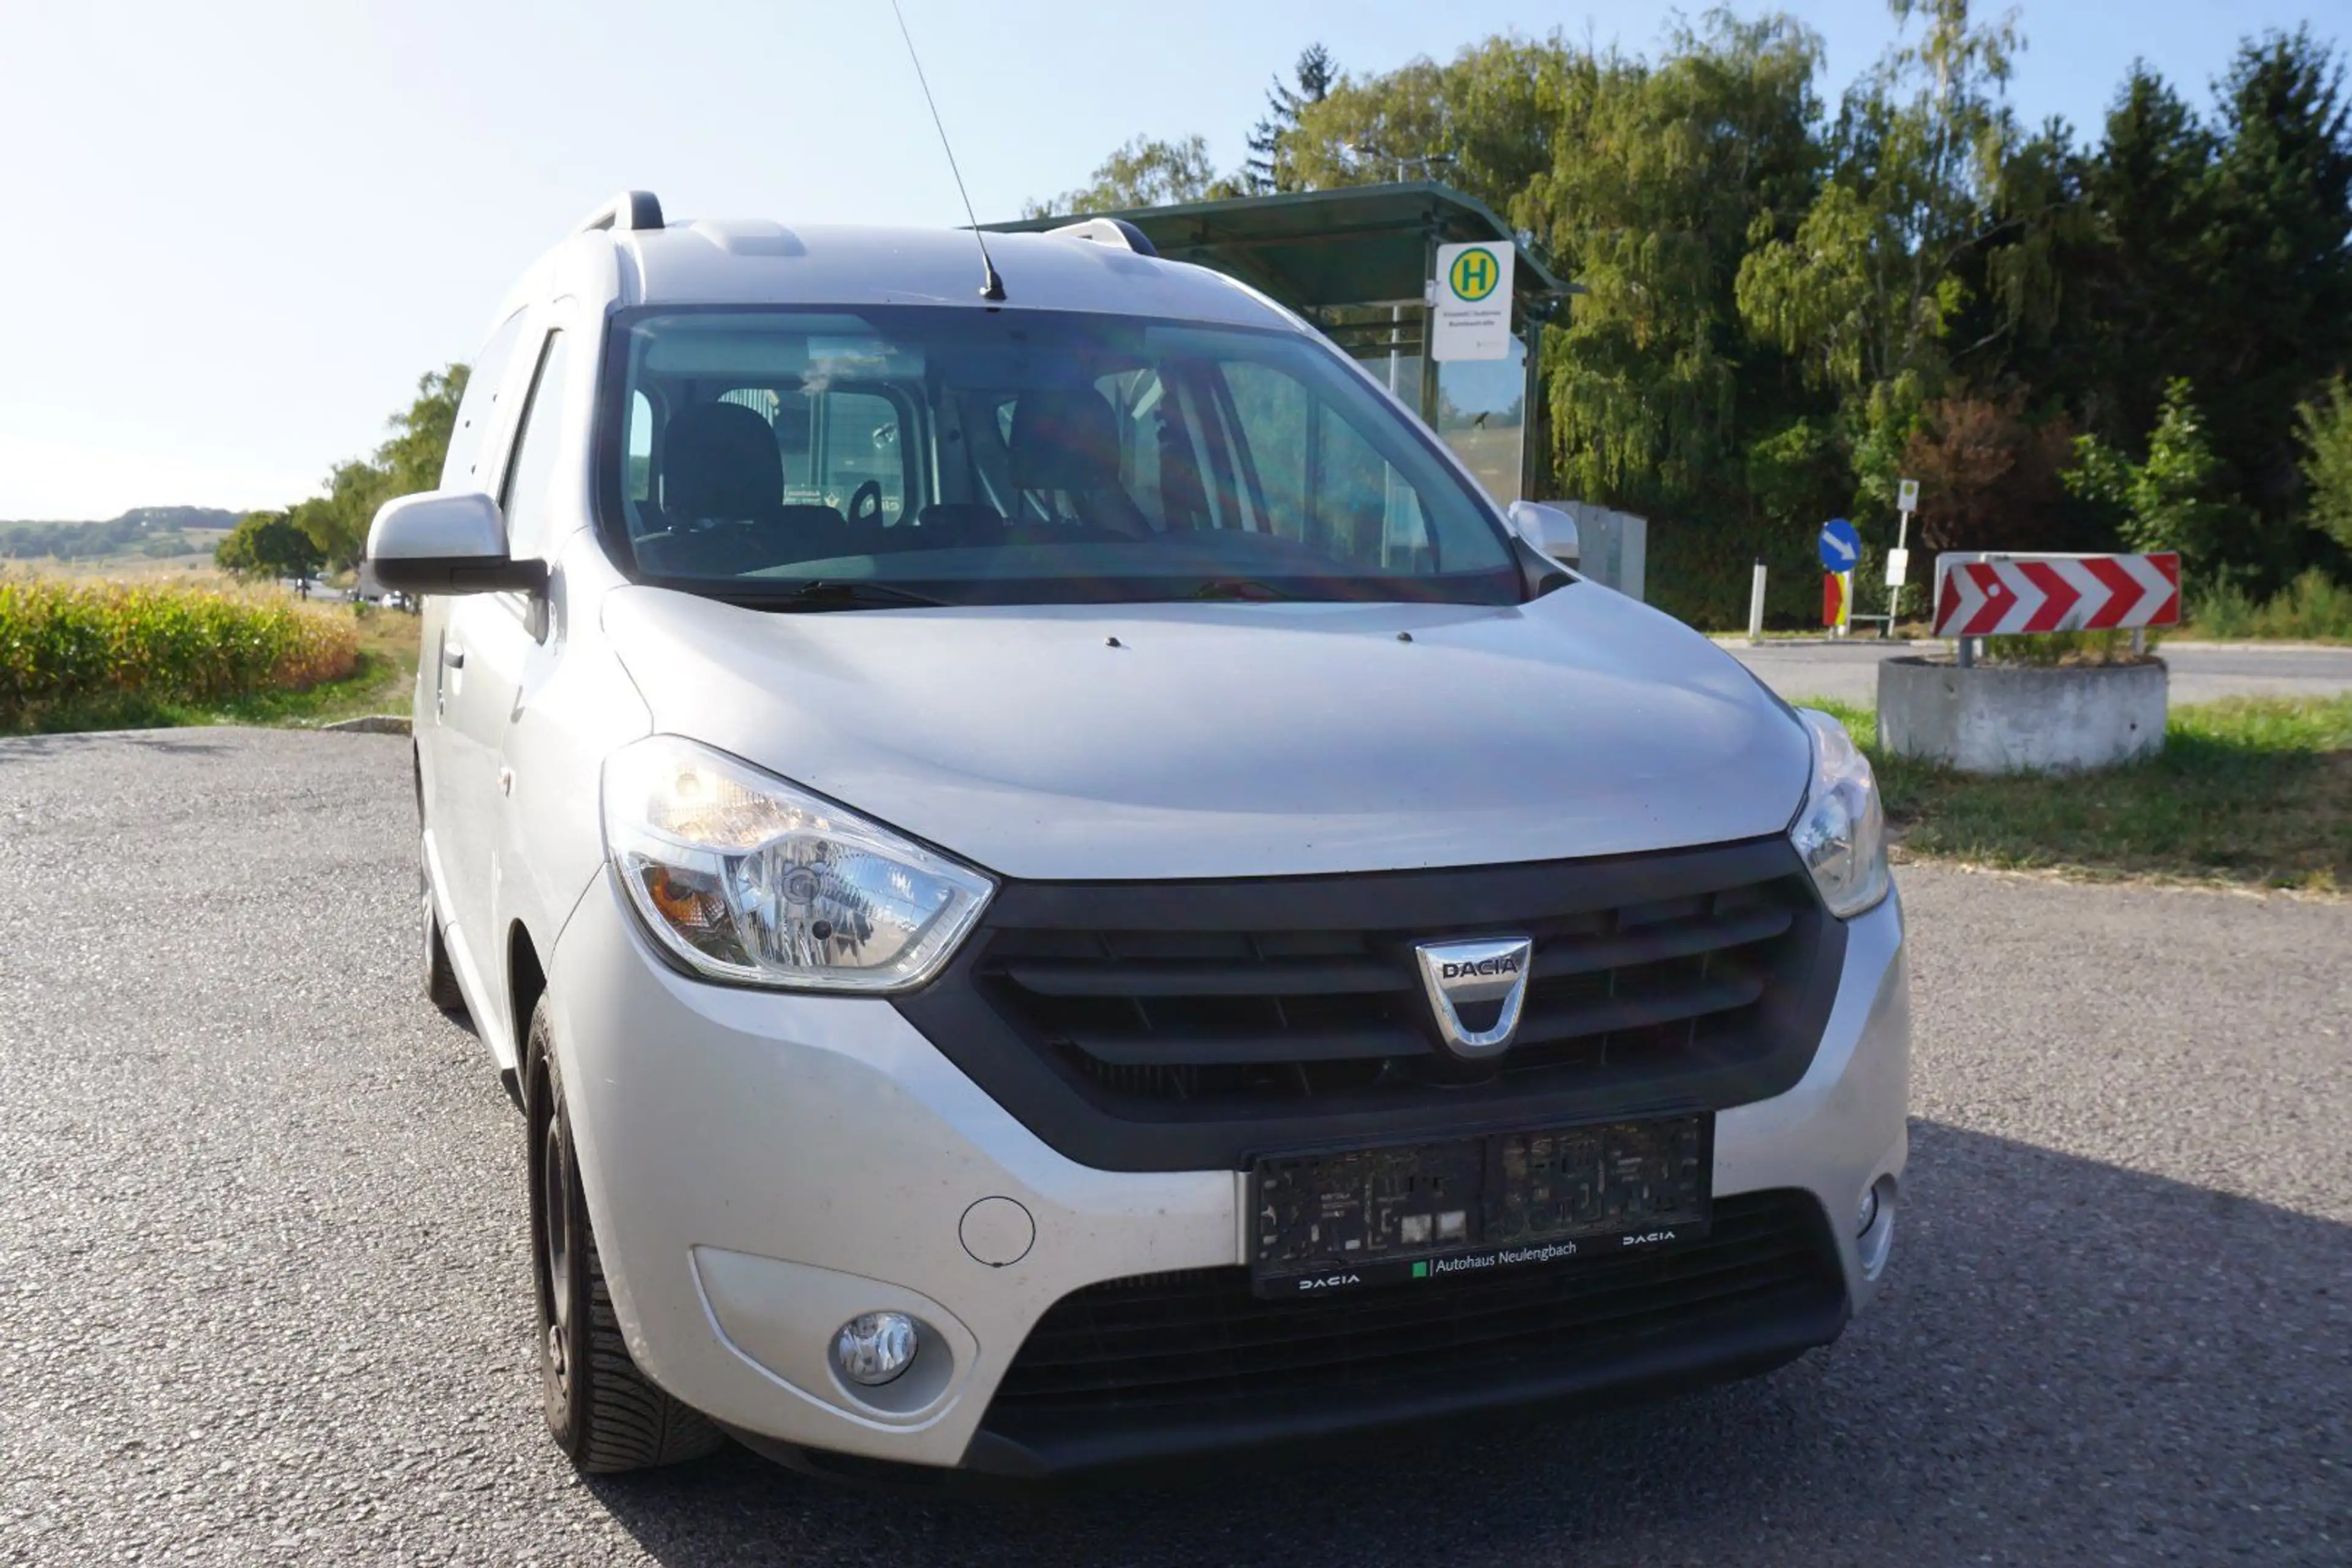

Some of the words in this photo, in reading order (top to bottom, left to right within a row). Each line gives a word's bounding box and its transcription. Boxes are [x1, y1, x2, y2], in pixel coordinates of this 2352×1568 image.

[1462, 258, 1488, 292] H
[1443, 957, 1518, 979] DACIA
[1623, 1231, 1675, 1246] DACIA
[1436, 1256, 1495, 1273] Autohaus
[1498, 1241, 1577, 1264] Neulengbach
[1299, 1274, 1360, 1290] DACIA
